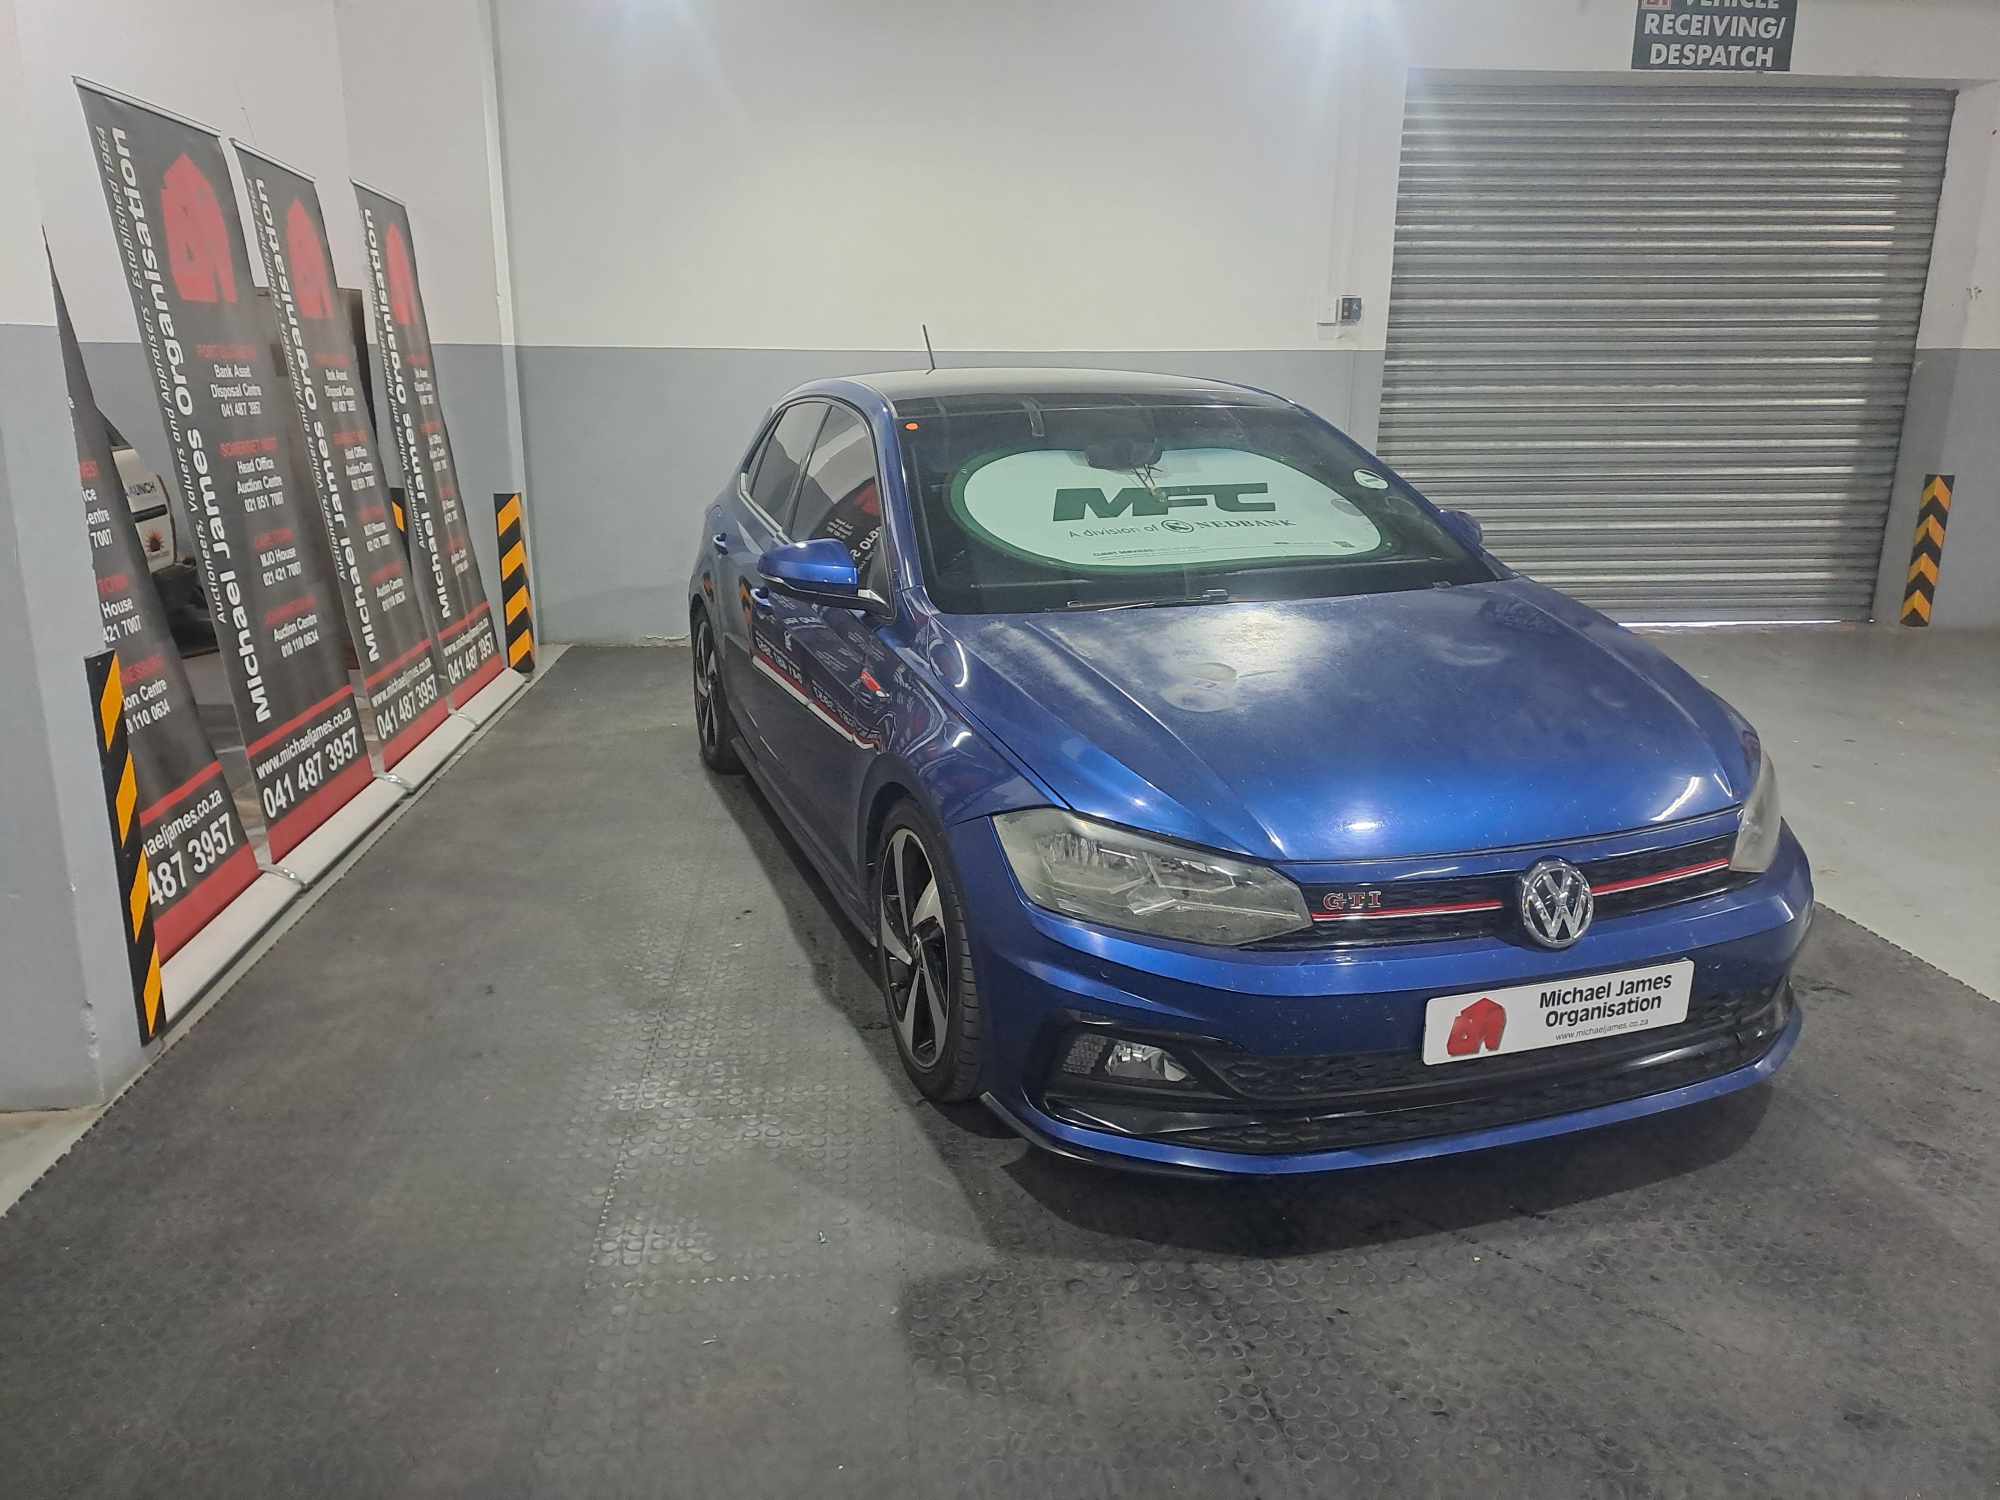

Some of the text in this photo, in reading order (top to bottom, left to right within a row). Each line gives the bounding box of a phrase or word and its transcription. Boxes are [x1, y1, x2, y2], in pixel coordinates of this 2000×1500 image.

[1644, 13, 1786, 39] RECEIVING/
[1649, 43, 1774, 67] DESPATCH
[107, 178, 143, 289] Established
[255, 178, 317, 410] Organisation
[364, 208, 407, 405] Organisation
[141, 306, 172, 404] Appraisers
[111, 127, 271, 723] Michael James Organisation
[163, 408, 180, 443] and
[176, 447, 199, 512] Valuers
[313, 420, 347, 528] James
[402, 412, 428, 504] James
[82, 488, 97, 502] ice
[86, 508, 110, 525] entre
[1052, 482, 1276, 521] MFC
[90, 528, 113, 548] 7007
[1083, 525, 1140, 537] division
[1143, 523, 1159, 533] of
[1194, 518, 1297, 529] NEDBANK
[195, 519, 226, 624] Auctioneers,
[420, 511, 451, 619] Michael
[101, 596, 133, 619] House
[121, 614, 142, 637] 7007
[338, 537, 381, 662] Michael
[447, 631, 494, 685] 041 487 3957
[139, 678, 167, 699] Centre
[150, 697, 171, 722] 0634
[376, 674, 439, 740] 041 487 3957
[256, 706, 352, 780] www.michaeljames.co.za
[263, 726, 359, 819] 041 487 3957
[148, 811, 236, 908] 487 3957
[1322, 890, 1383, 912] GTI
[1540, 974, 1672, 1008] Michael James
[1545, 995, 1662, 1027] Organisation
